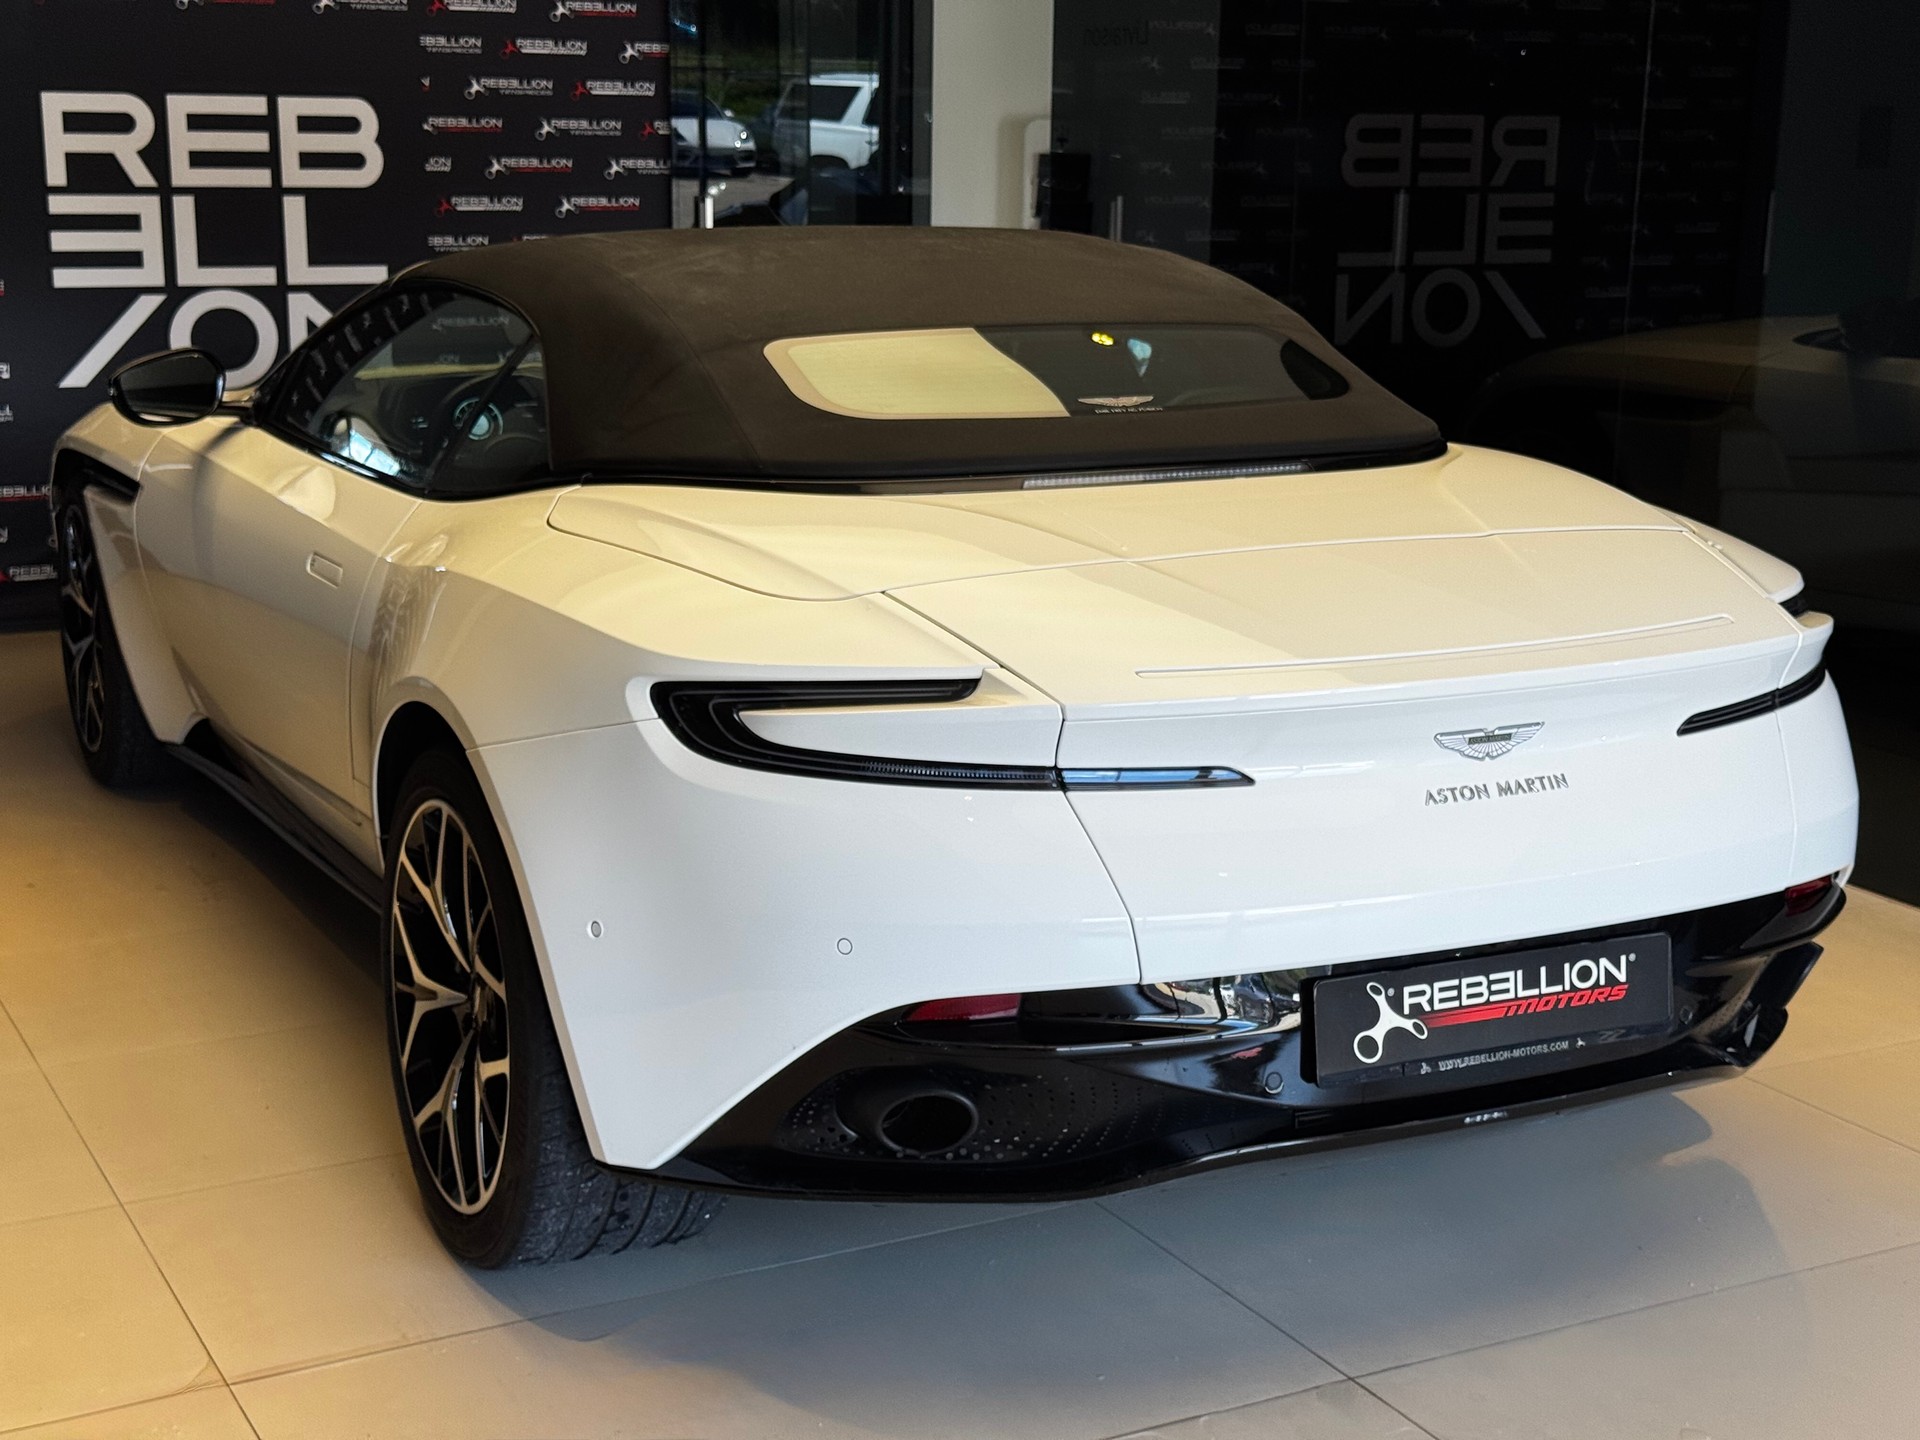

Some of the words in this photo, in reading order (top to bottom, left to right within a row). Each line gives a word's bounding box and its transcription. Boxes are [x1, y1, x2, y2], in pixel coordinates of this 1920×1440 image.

[566, 1, 637, 13] REBELLION
[517, 39, 587, 50] REBELLION
[481, 78, 553, 89] REBELLION
[586, 81, 655, 92] REBELLION
[428, 117, 502, 128] REBELLION
[551, 120, 622, 130] REBELLION
[40, 91, 384, 188] REB
[501, 158, 573, 168] REBELLION
[451, 197, 523, 207] REBELLION
[572, 197, 640, 207] REBELLION
[1425, 783, 1491, 806] ASTON
[1496, 773, 1569, 798] MARTIN
[1403, 955, 1627, 1015] REBELLION
[1500, 984, 1630, 1016] MOTORS
